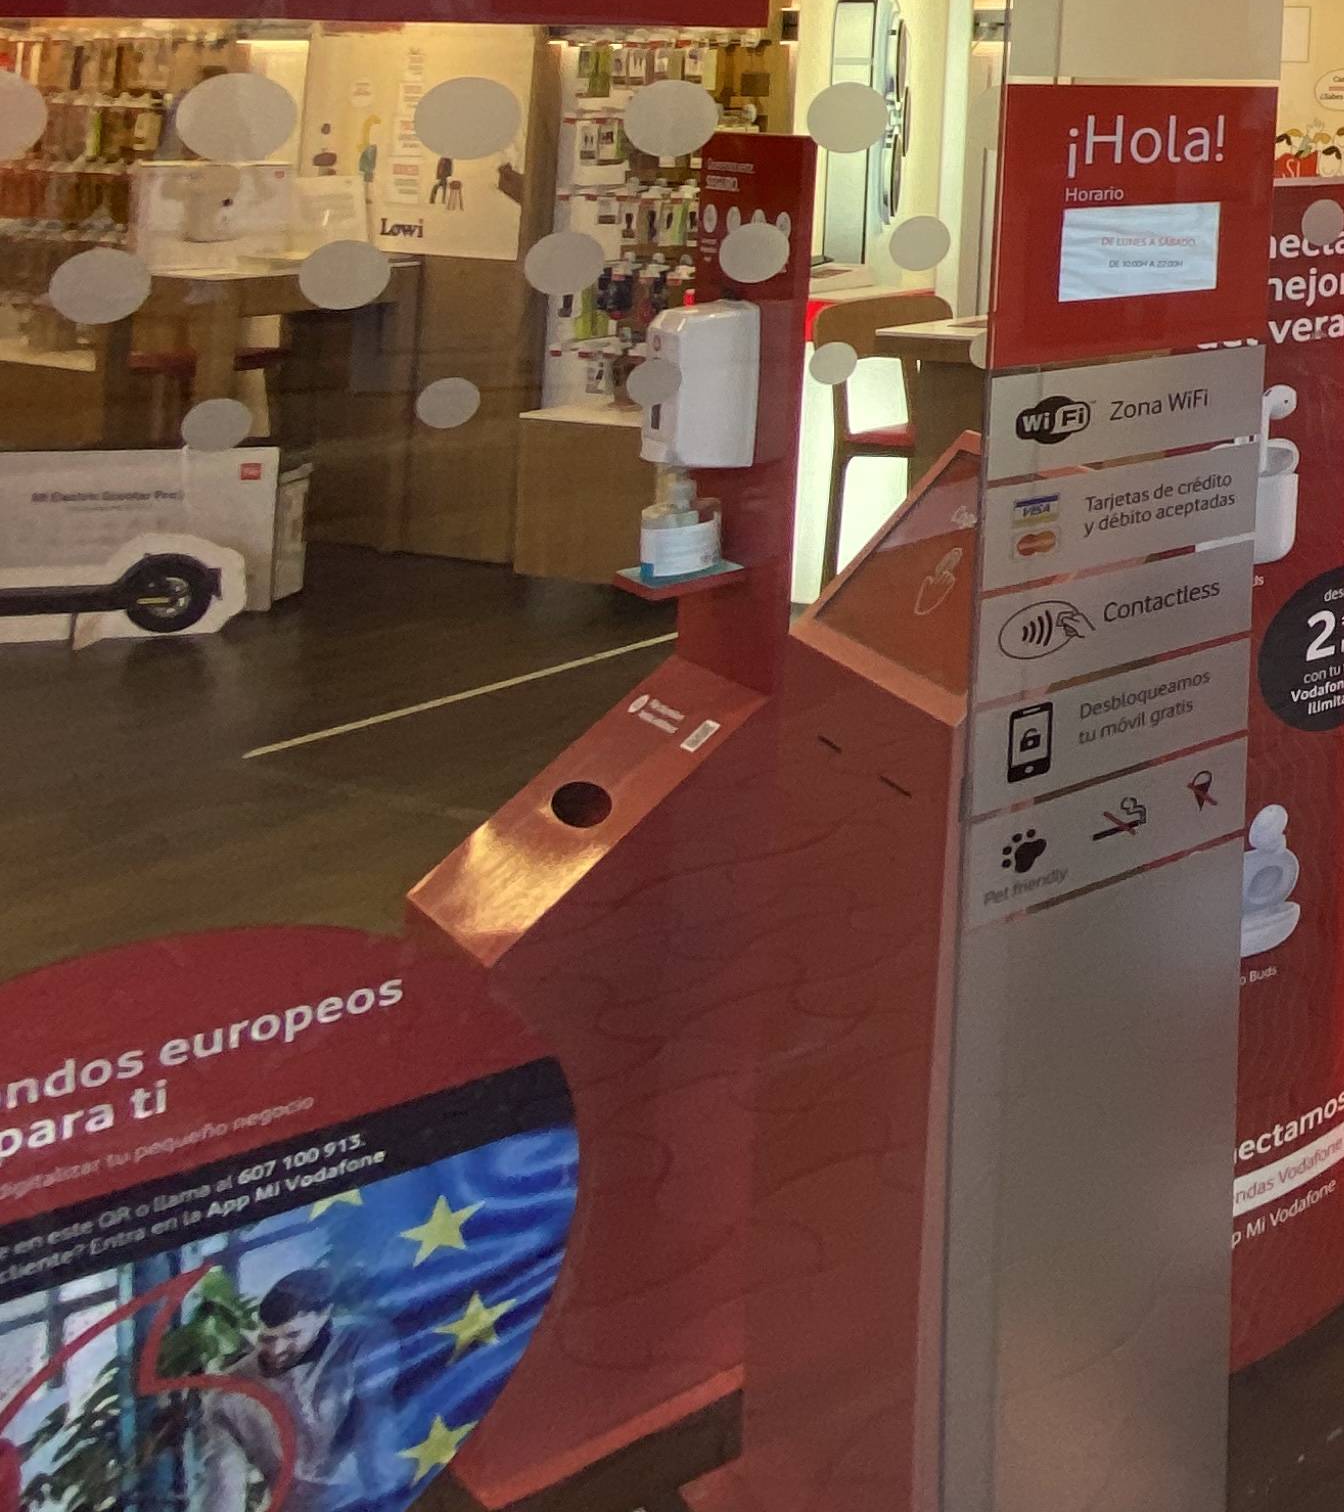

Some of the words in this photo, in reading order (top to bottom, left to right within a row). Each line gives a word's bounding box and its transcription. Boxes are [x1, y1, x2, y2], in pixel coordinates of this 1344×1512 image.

[1066, 114, 1225, 179] ¡Hola!
[1065, 186, 1125, 202] Horario
[381, 218, 424, 238] Lowi
[1110, 398, 1162, 421] Zona
[1168, 388, 1209, 411] WiFi
[1022, 503, 1050, 518] VISA
[1085, 489, 1150, 514] Tarjetas
[1153, 484, 1174, 500] de
[1178, 473, 1233, 496] crédito
[1084, 521, 1094, 538] y
[1098, 509, 1152, 531] débito
[1156, 493, 1236, 521] aceptadas
[1104, 581, 1220, 622] Contactless
[1306, 610, 1336, 662] 2
[1304, 668, 1327, 684] con
[1329, 662, 1341, 676] tu
[1079, 669, 1211, 720] Desbloqueamos
[1078, 729, 1097, 745] tu
[1100, 712, 1146, 739] móvil
[1150, 699, 1194, 725] gratis
[984, 886, 1009, 906] Pet
[1012, 867, 1069, 899] friendly
[1249, 965, 1277, 983] Buds
[6, 1049, 144, 1109] ndos
[158, 977, 404, 1067] europeos
[130, 1079, 168, 1119] ti
[232, 1096, 314, 1131] negocio
[1278, 1137, 1343, 1183] Vodafone
[98, 1206, 132, 1228] QR
[135, 1204, 150, 1217] o
[237, 1160, 276, 1185] 607
[282, 1147, 320, 1170] 100
[207, 1195, 250, 1219] App
[285, 1150, 387, 1192] Vodafone
[1246, 1216, 1266, 1239] Mi
[1269, 1179, 1337, 1228] Vodafone
